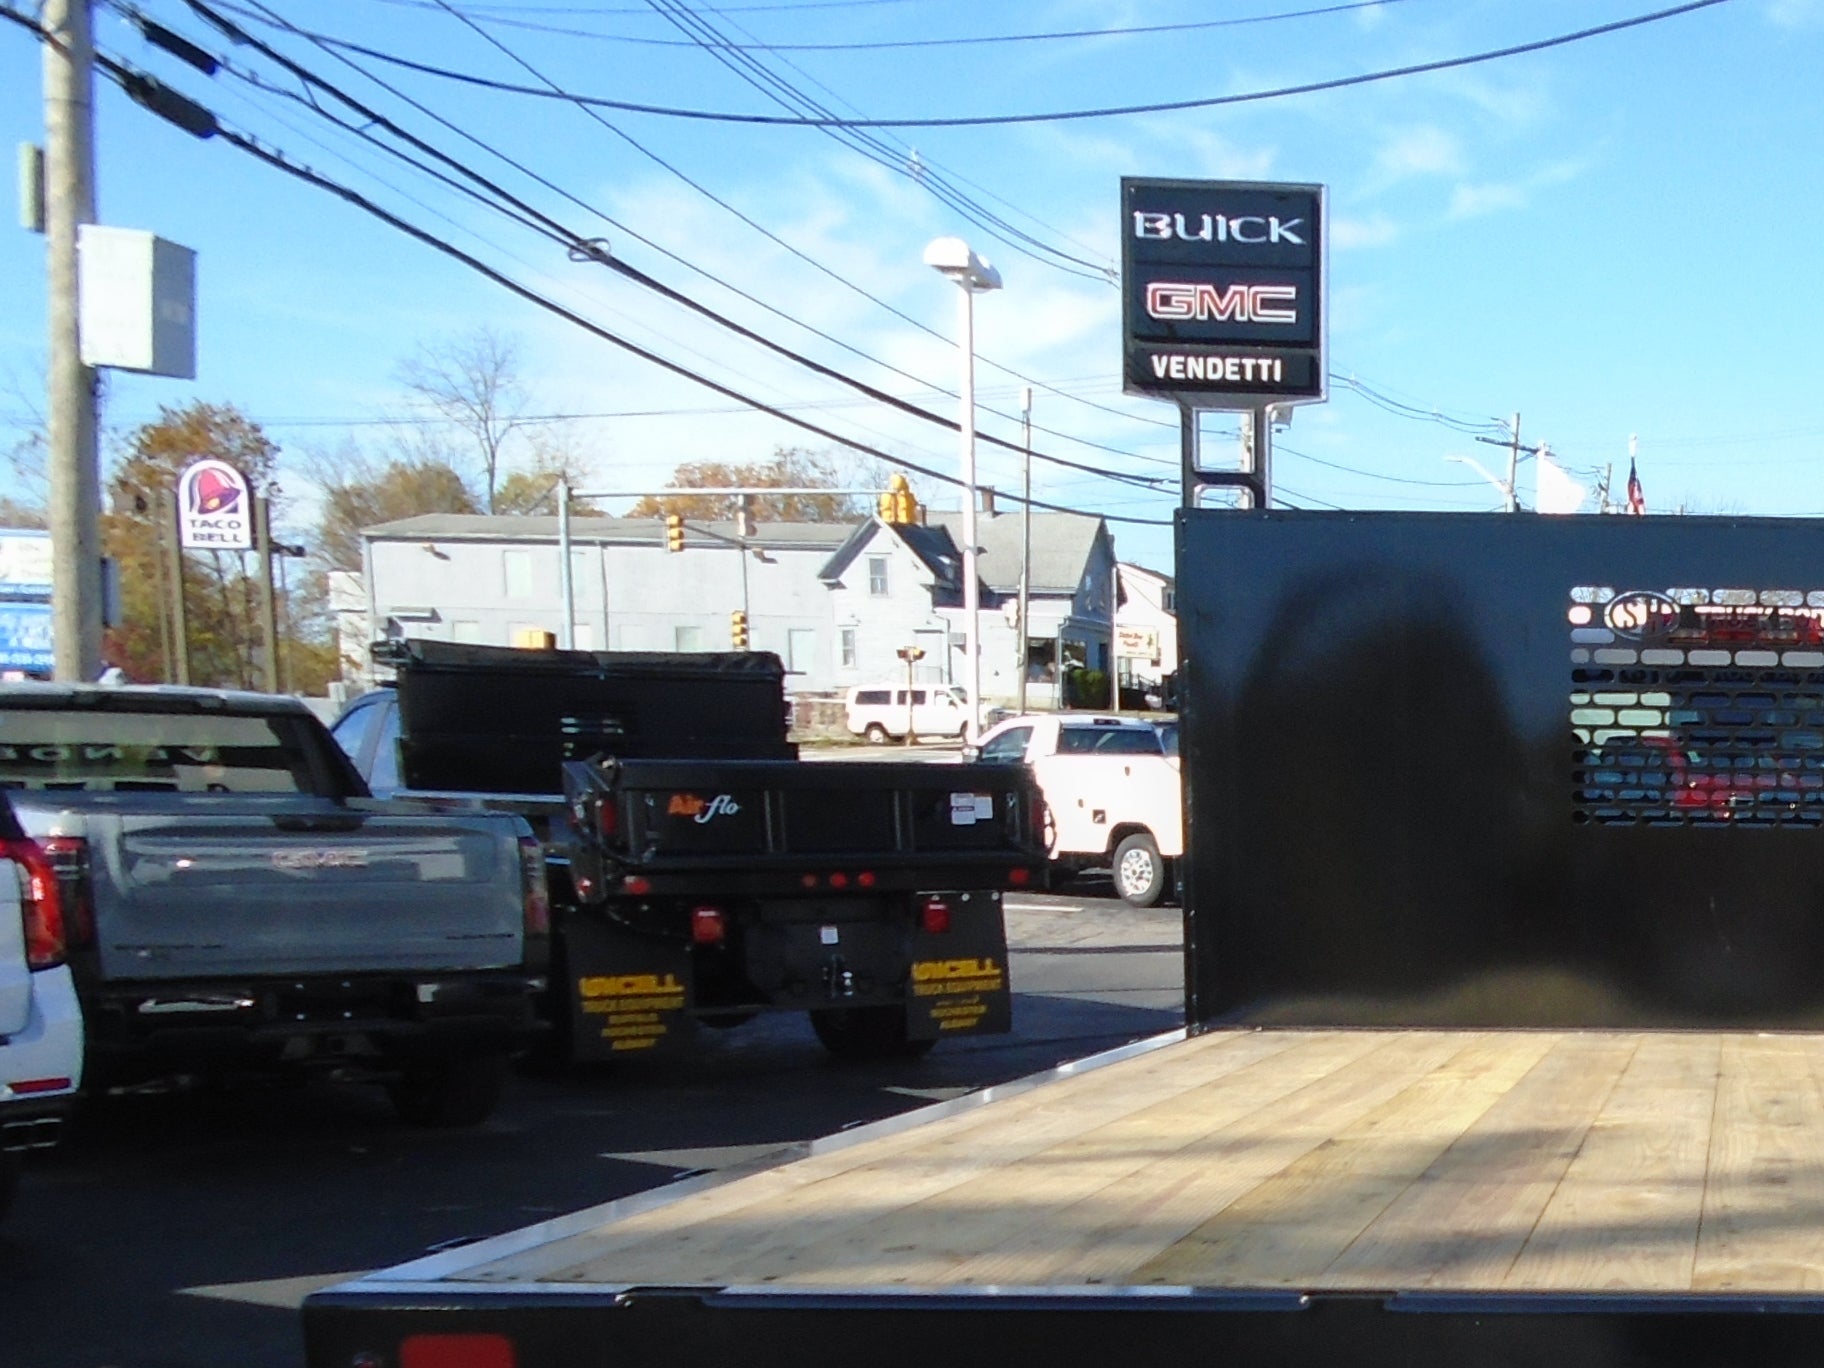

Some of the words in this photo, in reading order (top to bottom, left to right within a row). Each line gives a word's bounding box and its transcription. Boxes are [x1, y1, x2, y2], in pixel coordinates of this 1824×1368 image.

[1132, 210, 1307, 246] BUICK
[1146, 282, 1297, 325] GMC
[1151, 354, 1283, 384] VENDETTI
[190, 519, 242, 530] TACO
[193, 532, 243, 544] BELL
